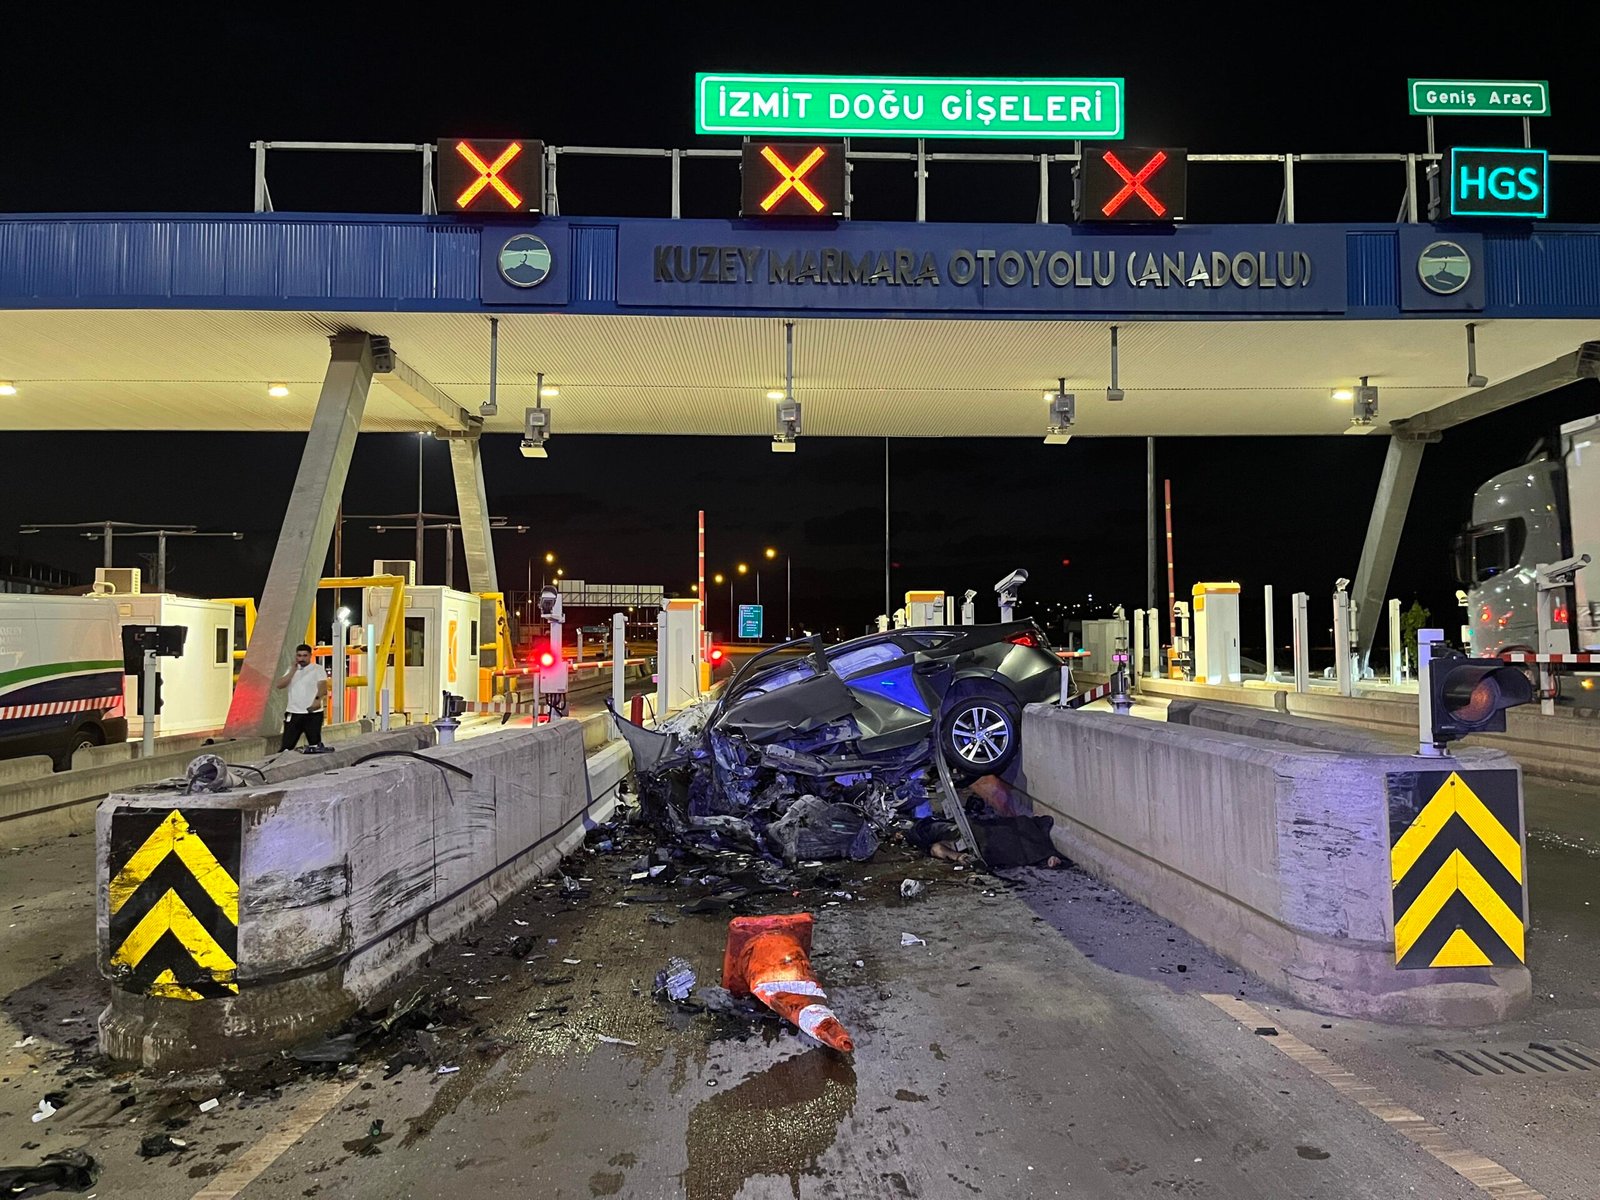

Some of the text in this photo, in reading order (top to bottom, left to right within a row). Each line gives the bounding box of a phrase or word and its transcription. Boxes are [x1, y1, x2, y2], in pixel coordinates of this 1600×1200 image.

[718, 85, 1102, 126] İZMİT DOĞU GİŞELERİ
[1426, 90, 1532, 107] Geniş Araç
[1460, 166, 1539, 200] HGS
[654, 246, 1311, 287] KUZEY MARMARA OTOYOLU (ANADOLU)
